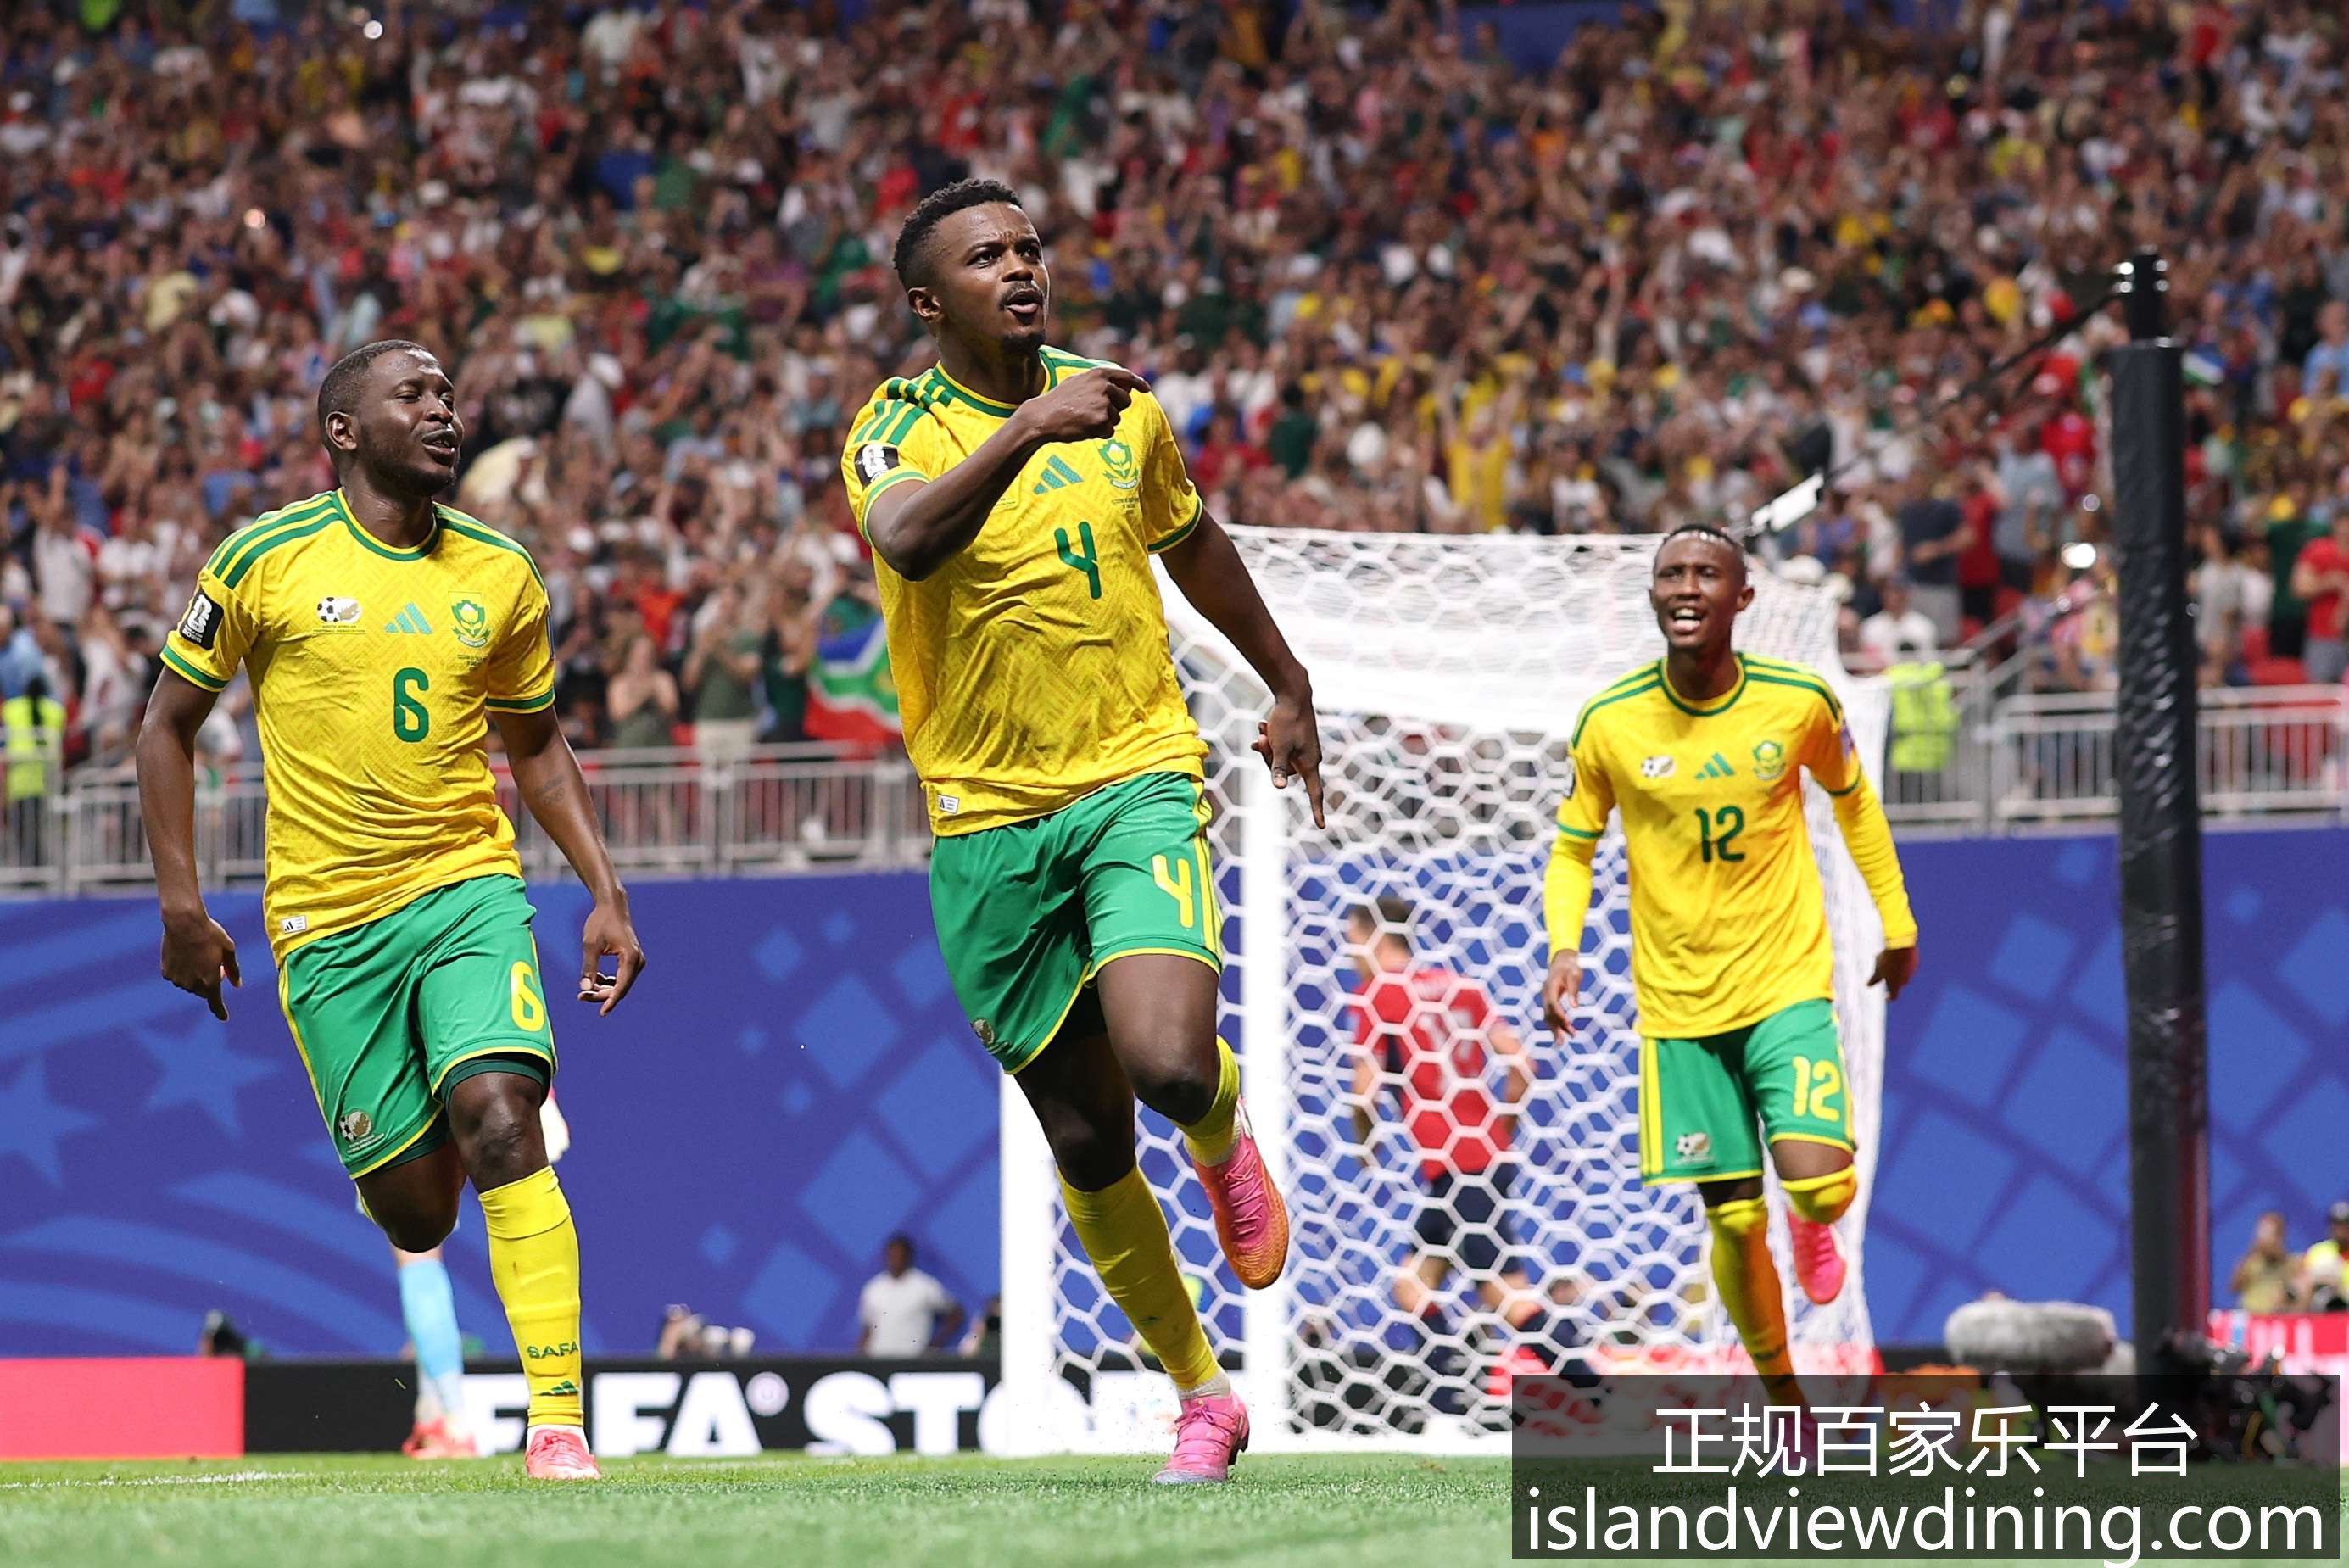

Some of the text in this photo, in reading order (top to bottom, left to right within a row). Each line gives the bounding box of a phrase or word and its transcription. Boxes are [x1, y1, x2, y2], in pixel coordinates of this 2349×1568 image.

[1054, 522, 1101, 599] 4
[394, 667, 429, 743] 6
[1696, 806, 1744, 862] 12
[1154, 856, 1194, 927] 4
[511, 962, 544, 1031] 6
[1794, 1057, 1841, 1120] 12
[527, 1341, 579, 1359] SAFA
[463, 1371, 762, 1458] FFA
